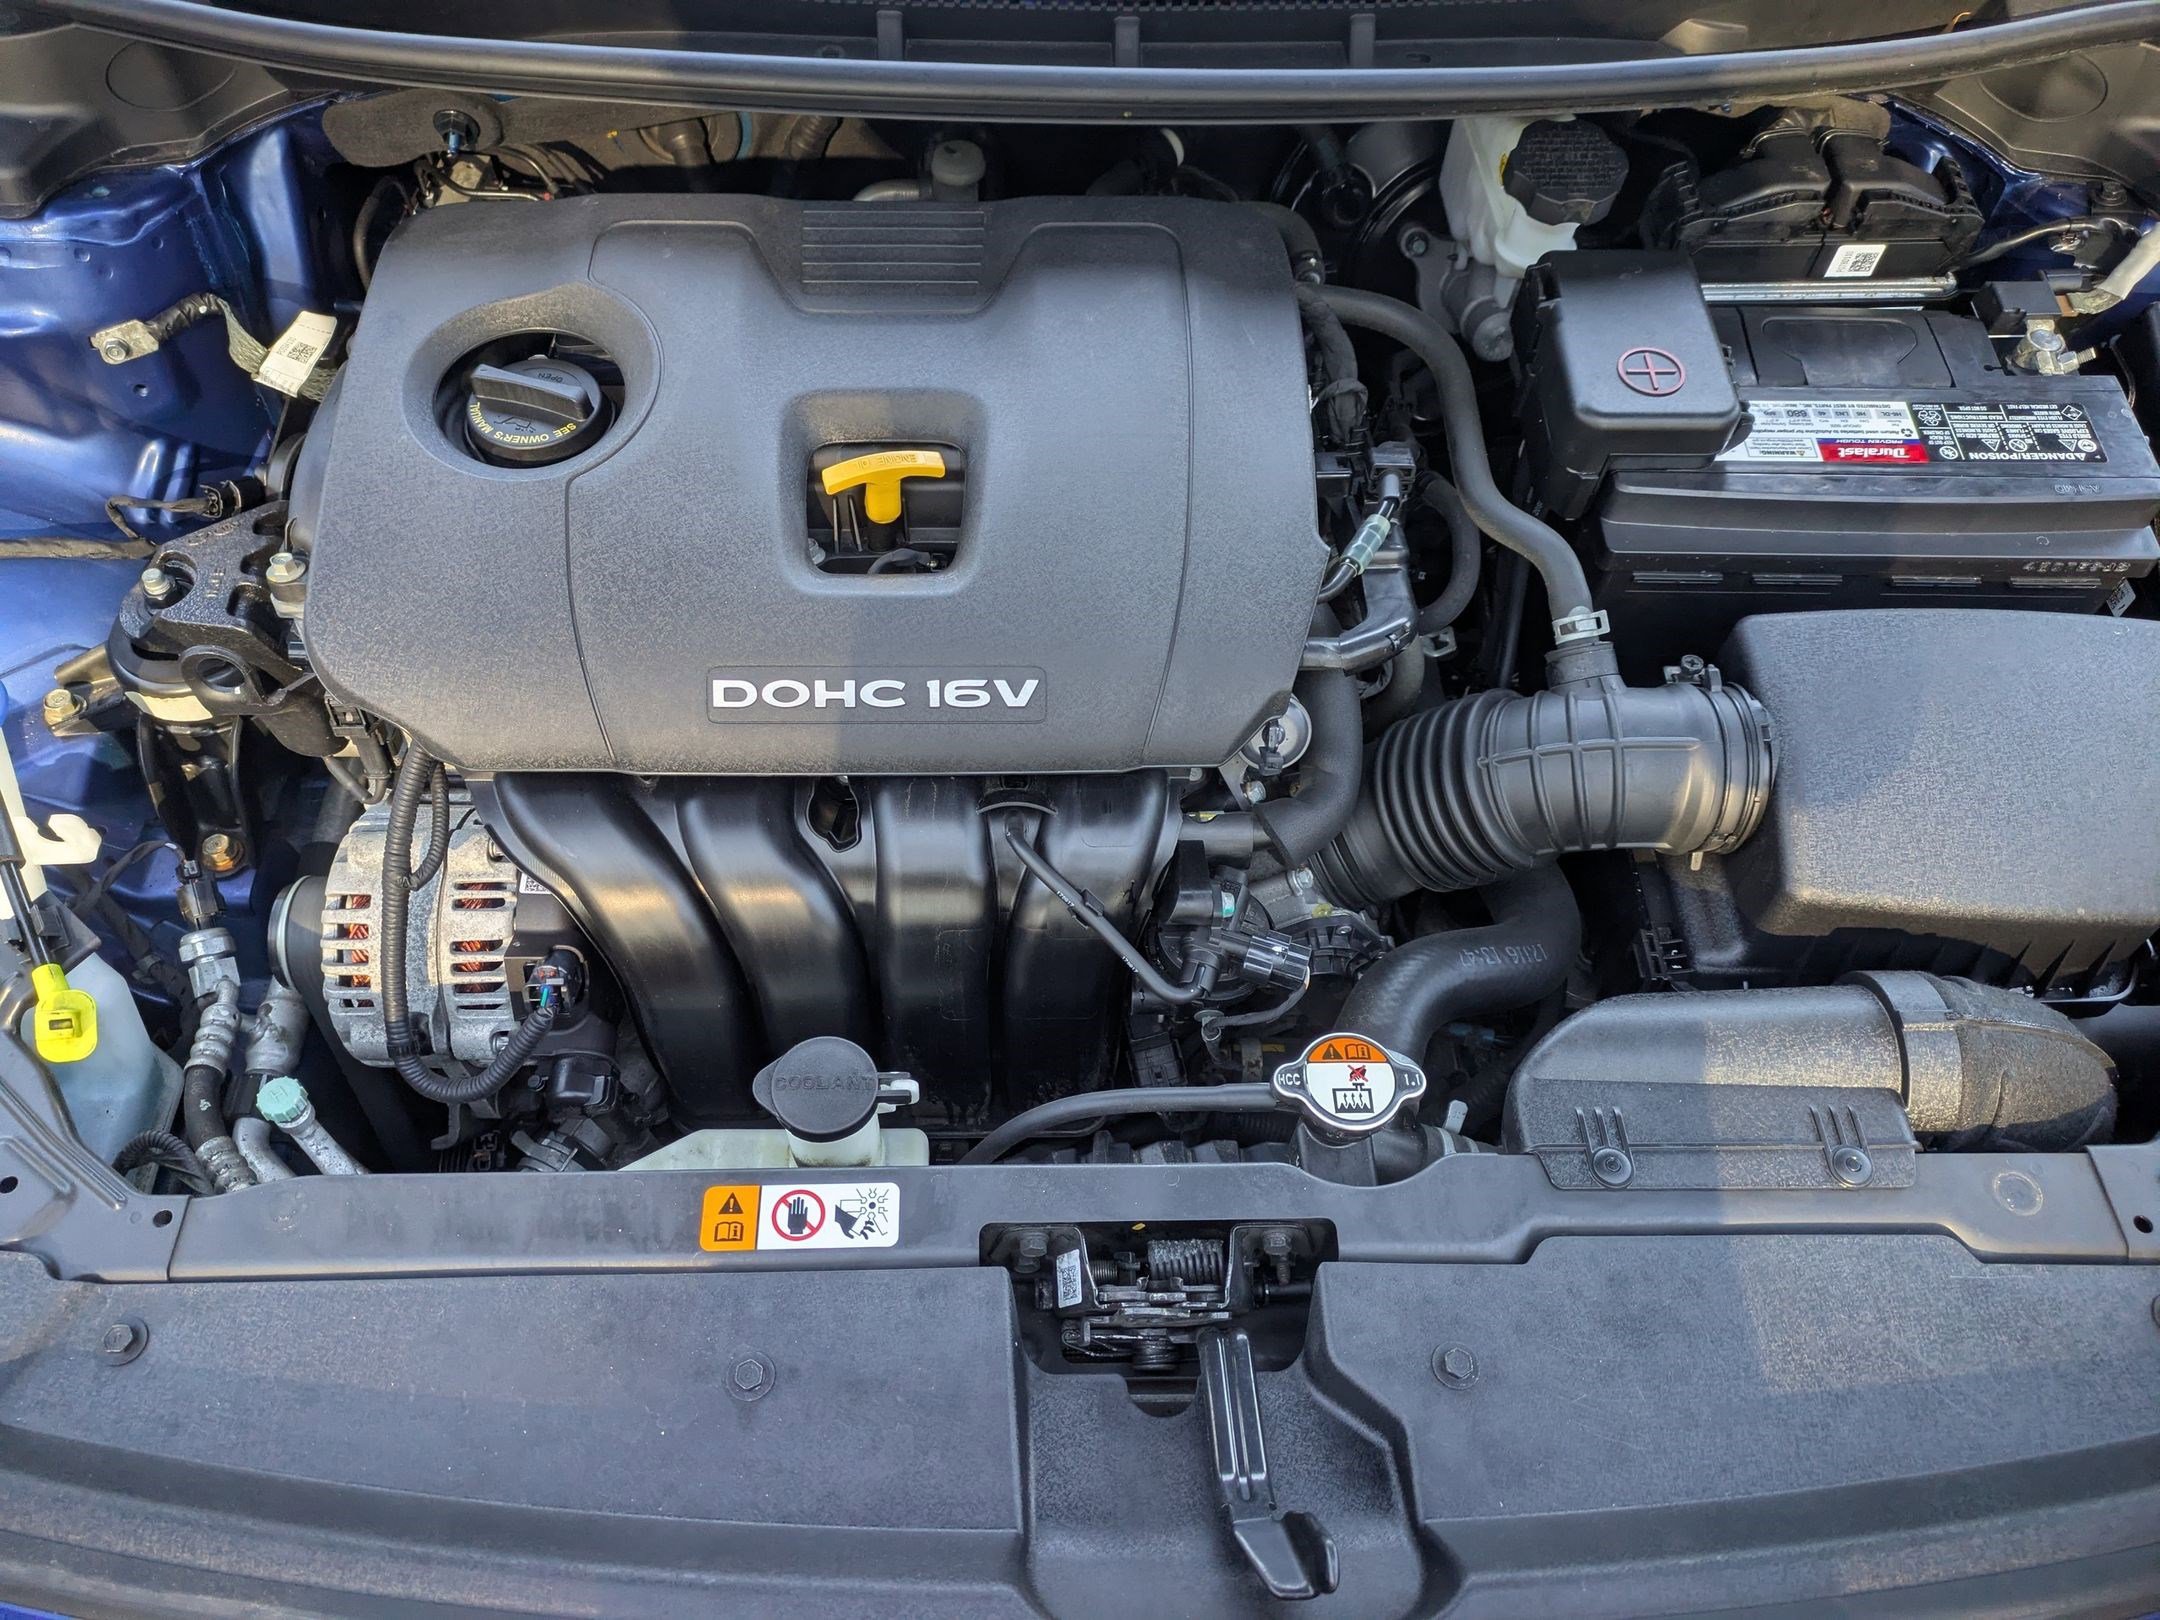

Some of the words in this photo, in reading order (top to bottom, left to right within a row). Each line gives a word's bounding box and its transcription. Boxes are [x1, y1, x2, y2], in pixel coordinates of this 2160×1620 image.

[538, 373, 563, 383] OPEN
[470, 402, 493, 433] MANUAL
[553, 423, 576, 437] SEE
[494, 432, 549, 443] OWNER'S
[878, 454, 917, 465] ENGINE
[1838, 448, 1909, 458] Duralast
[712, 679, 906, 708] DOHC
[926, 679, 1039, 708] 16V
[776, 1075, 871, 1091] COOLANT
[1277, 1073, 1301, 1086] HCC
[1404, 1073, 1421, 1086] 1.1
